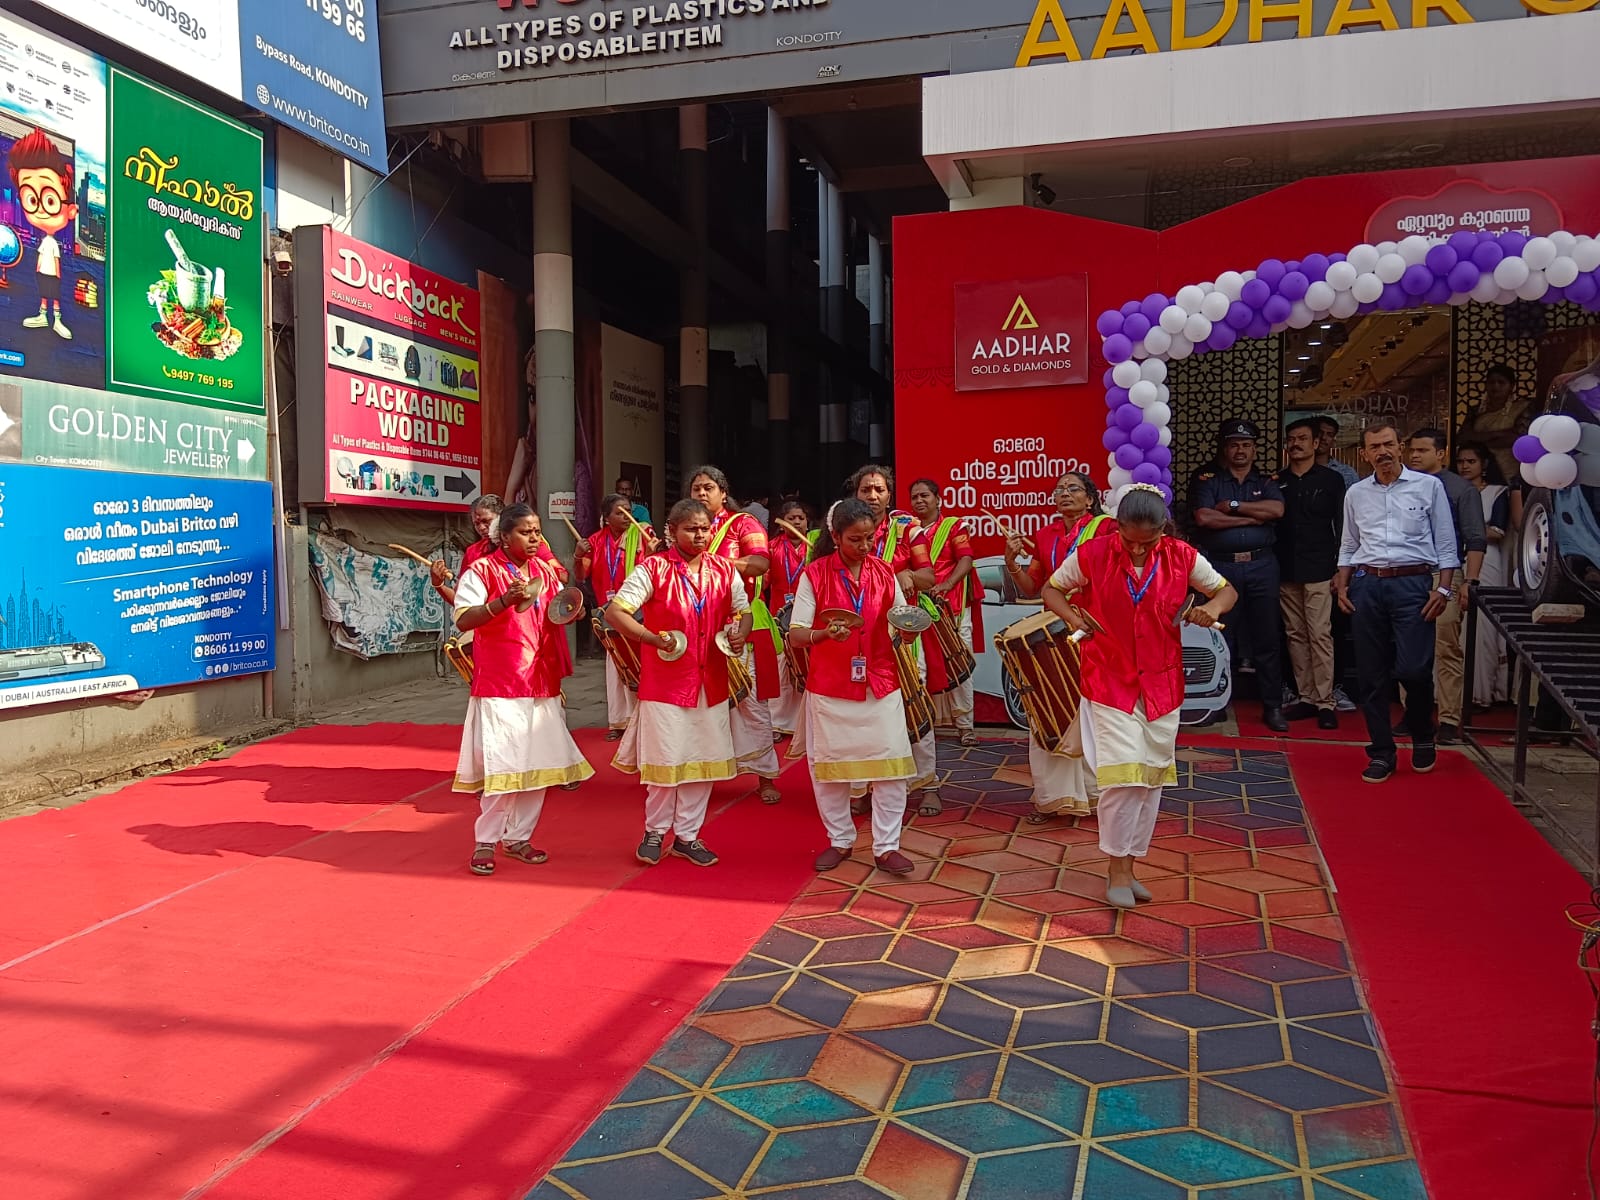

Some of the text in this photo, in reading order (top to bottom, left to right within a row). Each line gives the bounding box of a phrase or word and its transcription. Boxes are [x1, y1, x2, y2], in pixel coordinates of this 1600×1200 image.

[322, 0, 342, 26] 99
[346, 14, 366, 42] 66
[449, 0, 765, 48] ALL TYPES OF PLASTICS
[776, 31, 843, 46] KONDOTTY
[256, 35, 369, 110] Bypass Road, KONDOTTY
[272, 94, 371, 156] www.britco.co.in
[1397, 208, 1531, 233] ഏറ്റവും കുറഞ്ഞ
[331, 248, 476, 336] Duckback
[331, 290, 373, 311] RAINWEAR
[394, 312, 428, 330] LUGGAGE
[972, 332, 1071, 360] AADHAR
[171, 369, 234, 388] 9497 769 195
[971, 360, 1071, 375] GOLD & DIAMONDS
[350, 377, 465, 426] PACKAGING
[49, 404, 232, 452] GOLDEN CITY
[378, 412, 449, 447] WORLD
[993, 437, 1044, 453] ഓരോ
[163, 449, 231, 469] JEWELLERY
[93, 501, 129, 515] ഓരോ
[132, 499, 139, 513] 3
[141, 518, 179, 535] Dubai
[181, 516, 217, 532] Britco
[219, 513, 239, 529] വഴി
[139, 540, 174, 559] ജോലി
[113, 570, 253, 602] Smartphone Technology
[194, 632, 232, 643] KONDOTTY
[204, 639, 266, 656] 8606 11 99 00
[5, 680, 127, 702] DUBAI AUSTRALIA EAST AFRICA
